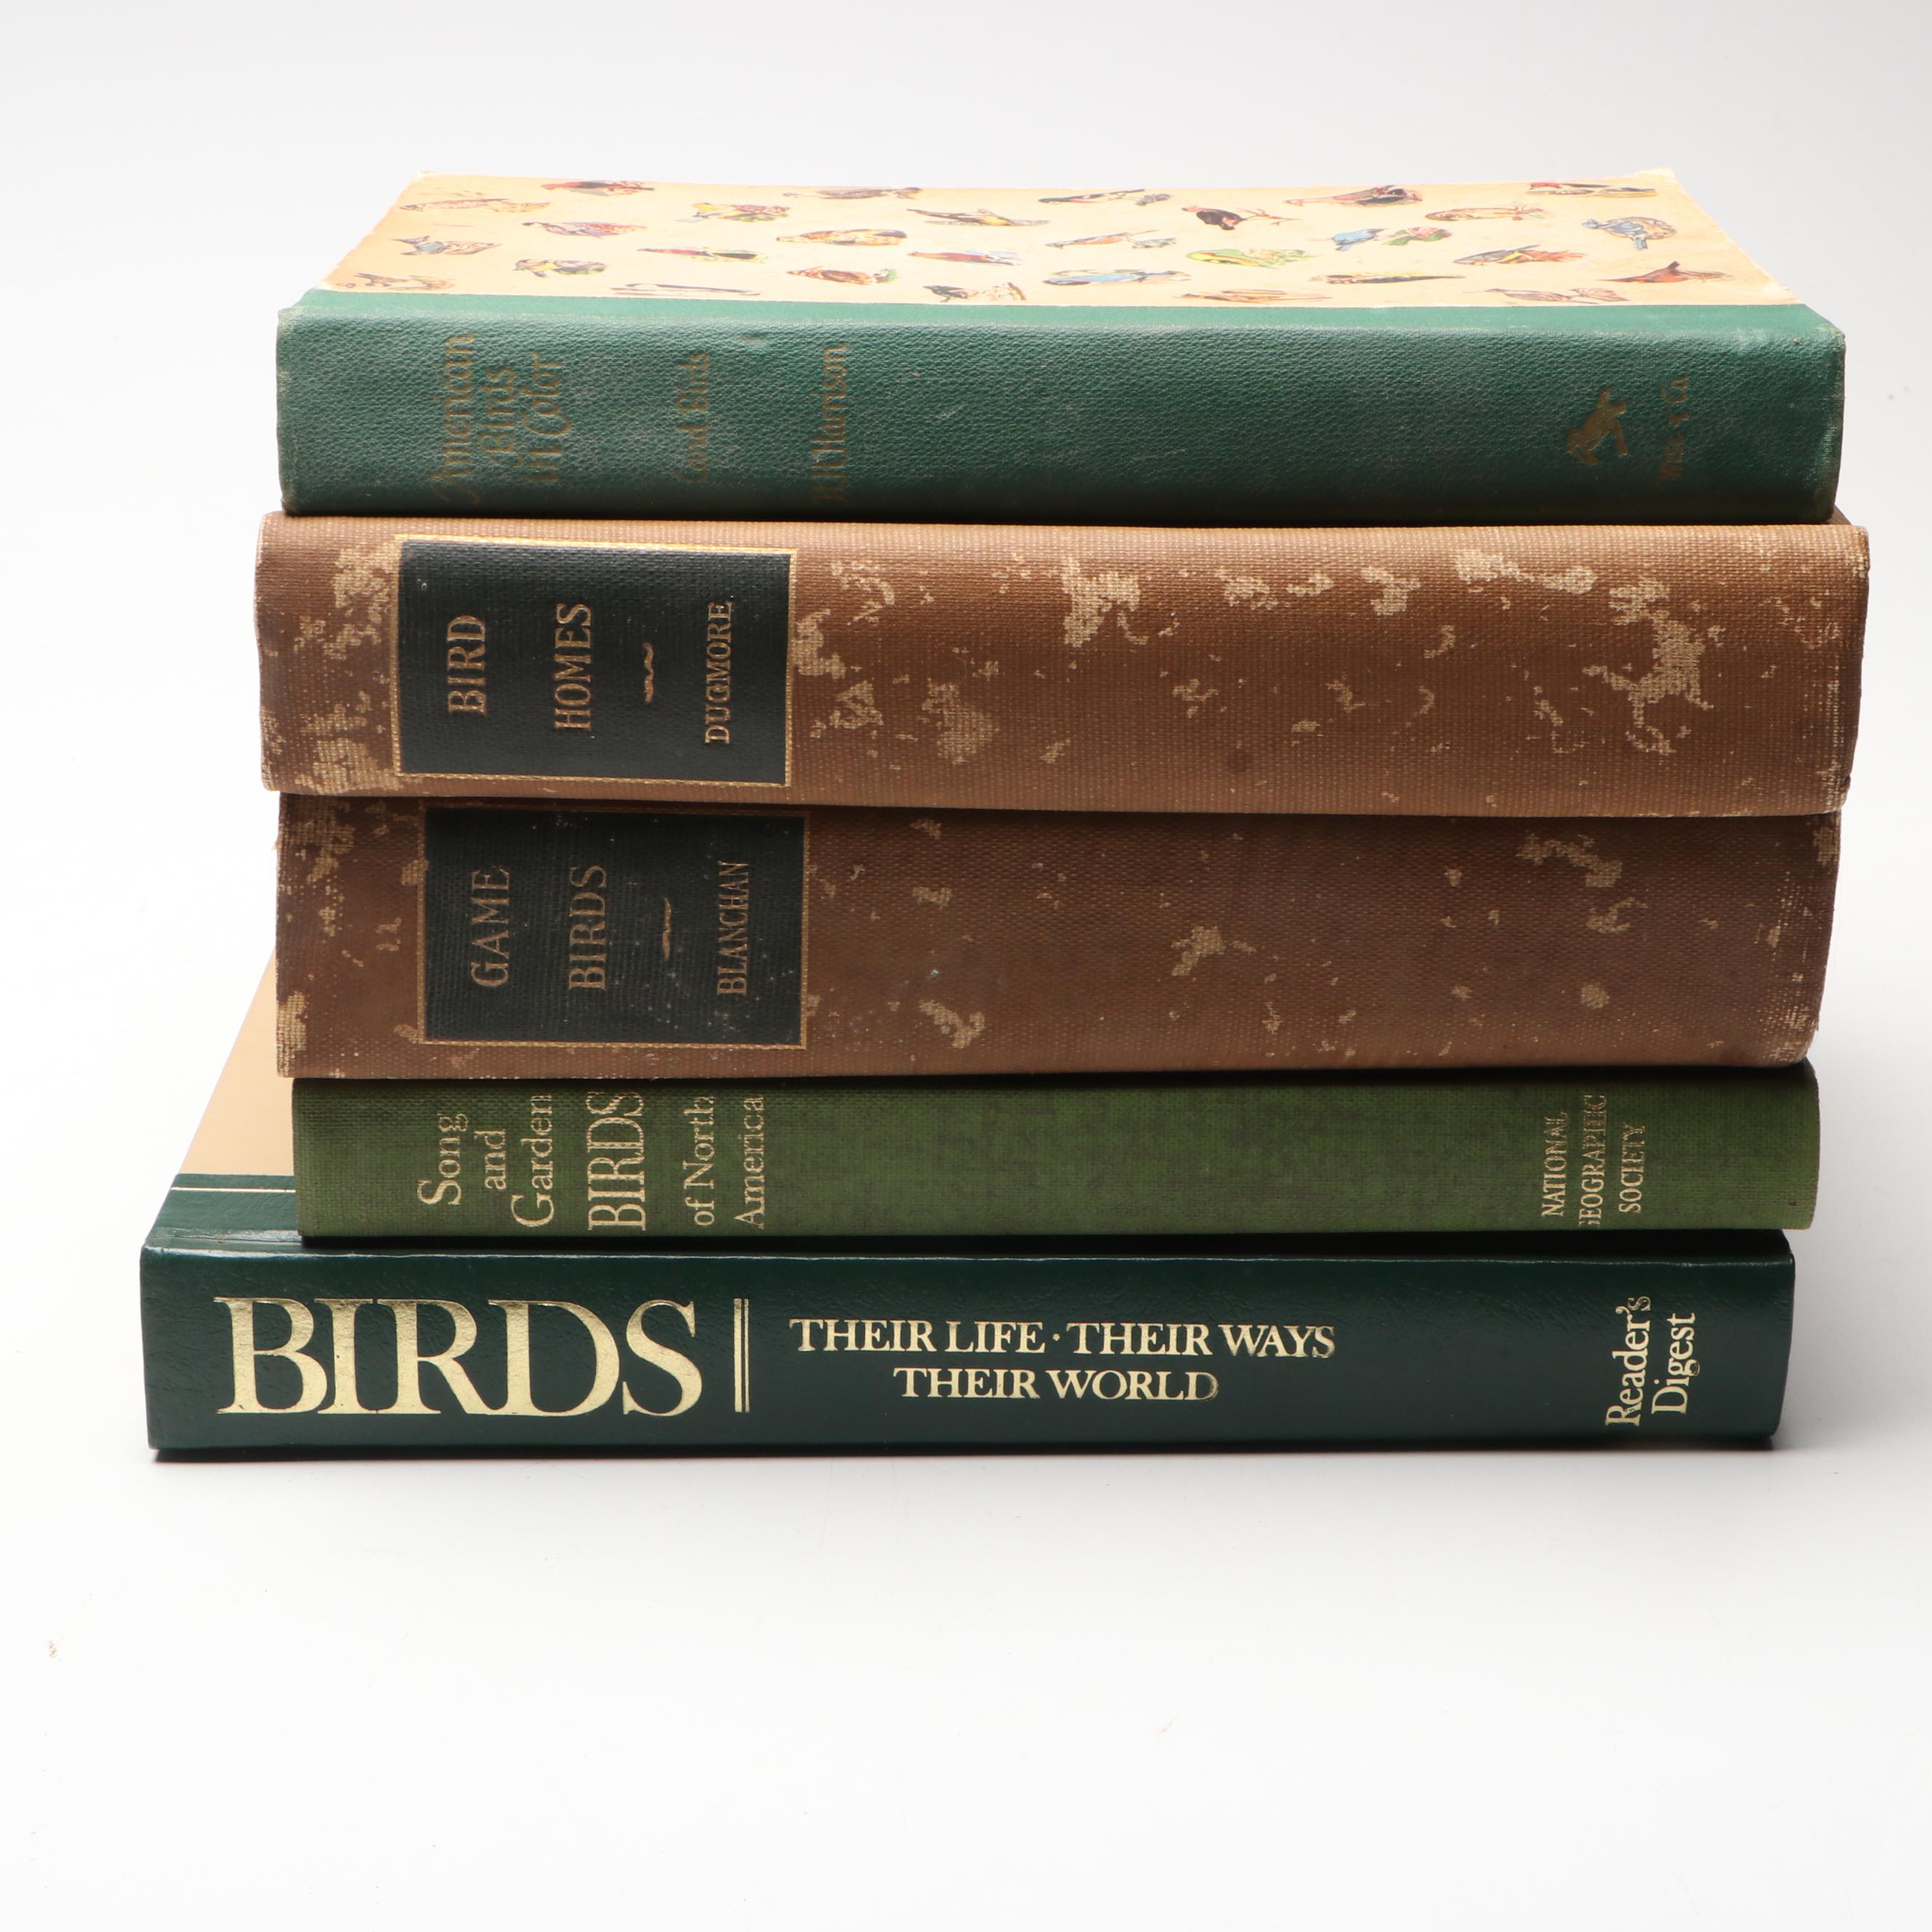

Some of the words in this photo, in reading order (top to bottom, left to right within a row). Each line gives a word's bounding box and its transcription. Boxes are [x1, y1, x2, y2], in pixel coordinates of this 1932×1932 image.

[428, 332, 476, 509] American
[477, 367, 522, 475] Birds
[519, 350, 570, 437] Color
[447, 615, 487, 716] BIRD
[554, 603, 592, 731] HOMES
[704, 599, 733, 744] DUGMORE
[470, 866, 511, 988] GAME
[568, 865, 607, 990] BIRDS
[716, 861, 749, 996] BLANCHAN
[417, 1114, 468, 1206] Song
[474, 1130, 507, 1191] and
[510, 1094, 555, 1228] Garden
[586, 1091, 647, 1232] BIRDS
[682, 1095, 715, 1190] North
[735, 1095, 765, 1230] America
[1541, 1111, 1568, 1217] NATIONAL
[1618, 1122, 1646, 1213] SOCIETY
[686, 1197, 715, 1226] of
[213, 1297, 703, 1416] BIRDS
[789, 1318, 937, 1353] THEIR
[946, 1320, 1045, 1354] LIFE
[1066, 1322, 1213, 1357] THEIR
[1219, 1324, 1336, 1359] WAYS
[893, 1367, 1041, 1399] THEIR
[1045, 1369, 1220, 1402] WORLD
[1605, 1296, 1651, 1426] Reader's
[1651, 1312, 1701, 1414] Digest
